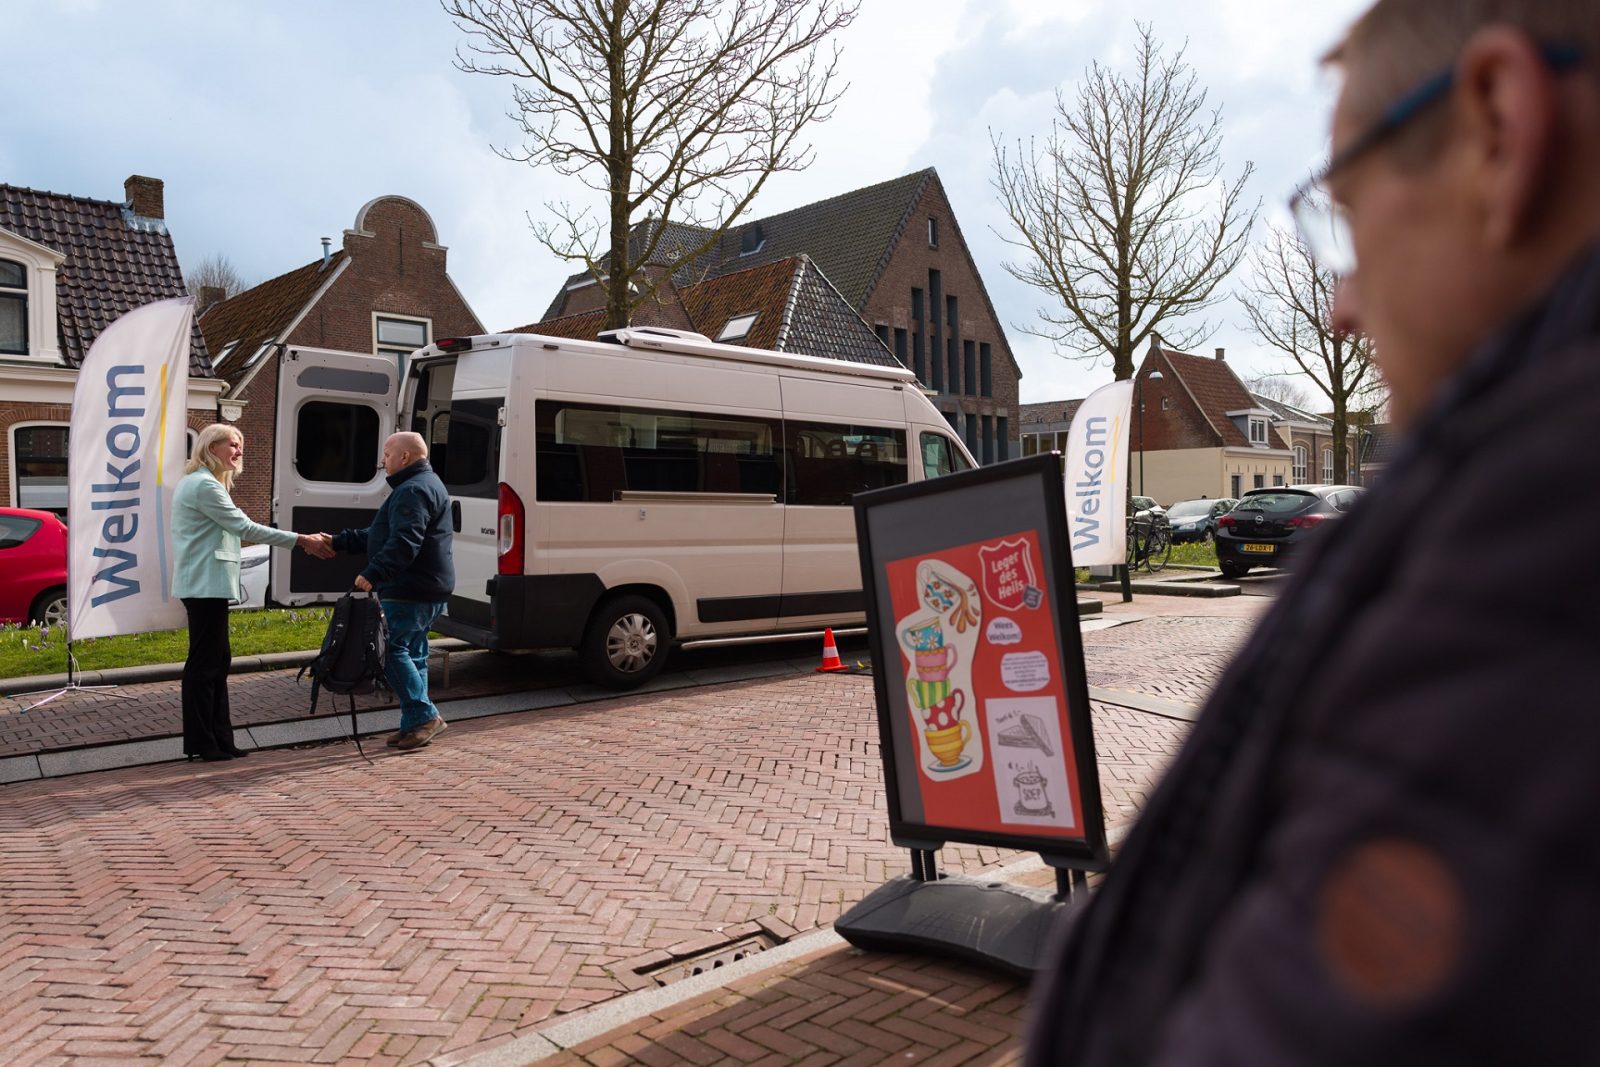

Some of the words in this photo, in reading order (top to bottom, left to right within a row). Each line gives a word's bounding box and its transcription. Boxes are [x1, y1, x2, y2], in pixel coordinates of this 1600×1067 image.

[91, 364, 146, 609] Welkom
[1072, 416, 1107, 551] Welkom
[991, 551, 1019, 574] Leger
[999, 568, 1018, 585] des
[998, 580, 1025, 601] Heils
[993, 621, 1014, 630] Wees
[1022, 787, 1041, 802] SOEP
